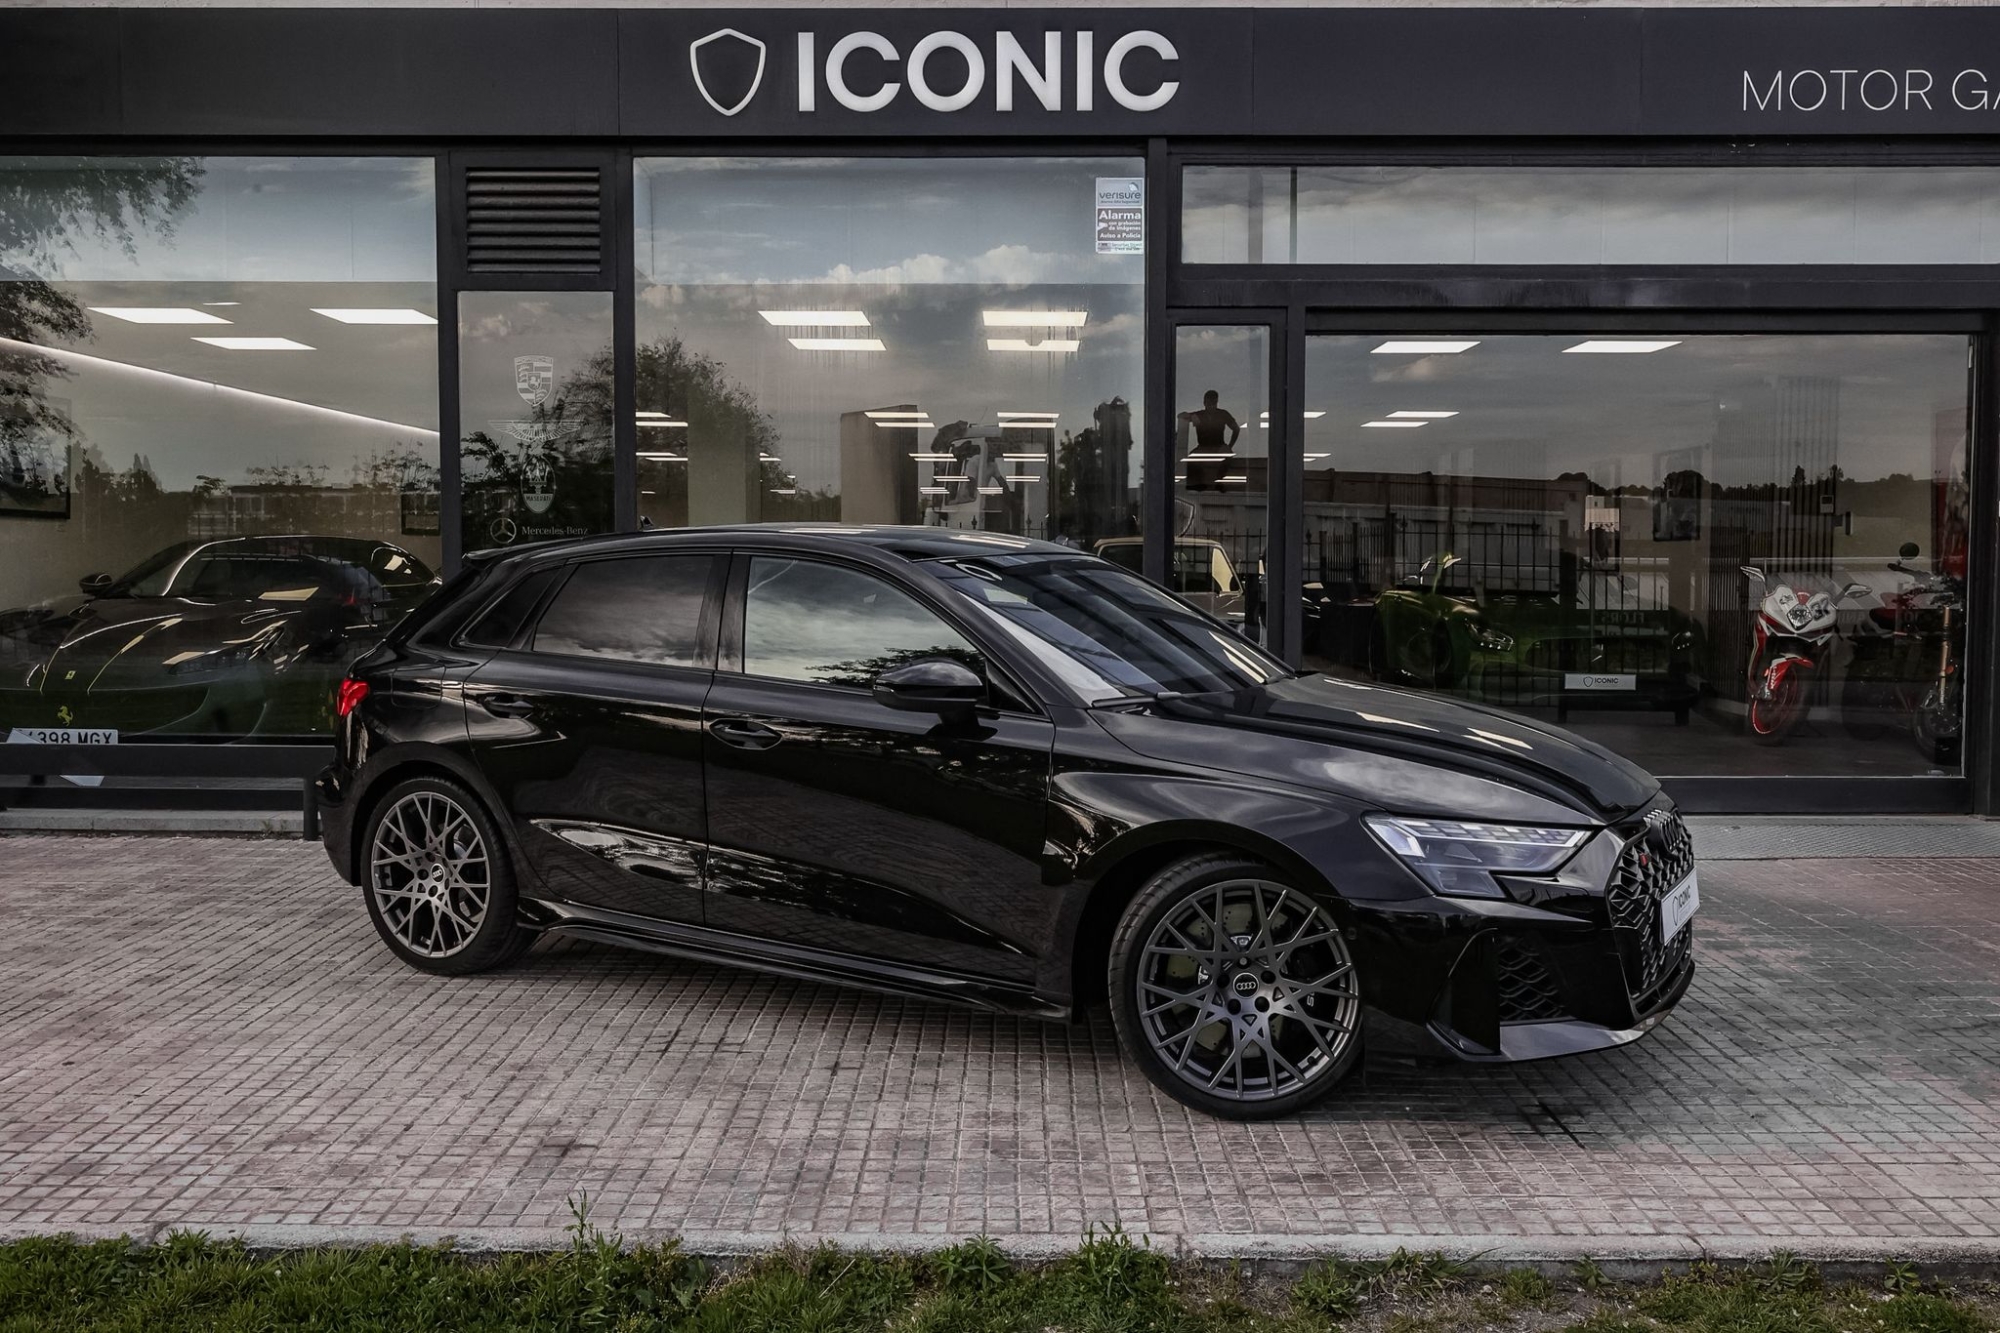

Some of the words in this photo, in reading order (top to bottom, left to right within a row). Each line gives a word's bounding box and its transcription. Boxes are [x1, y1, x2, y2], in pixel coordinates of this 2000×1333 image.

[798, 30, 1180, 112] ICONIC
[1743, 69, 1933, 111] MOTOR
[1952, 69, 2000, 110] G
[1099, 191, 1142, 199] verisure
[1099, 210, 1142, 220] Alarma
[521, 526, 588, 535] Mercedes-Benz
[28, 731, 70, 744] 398
